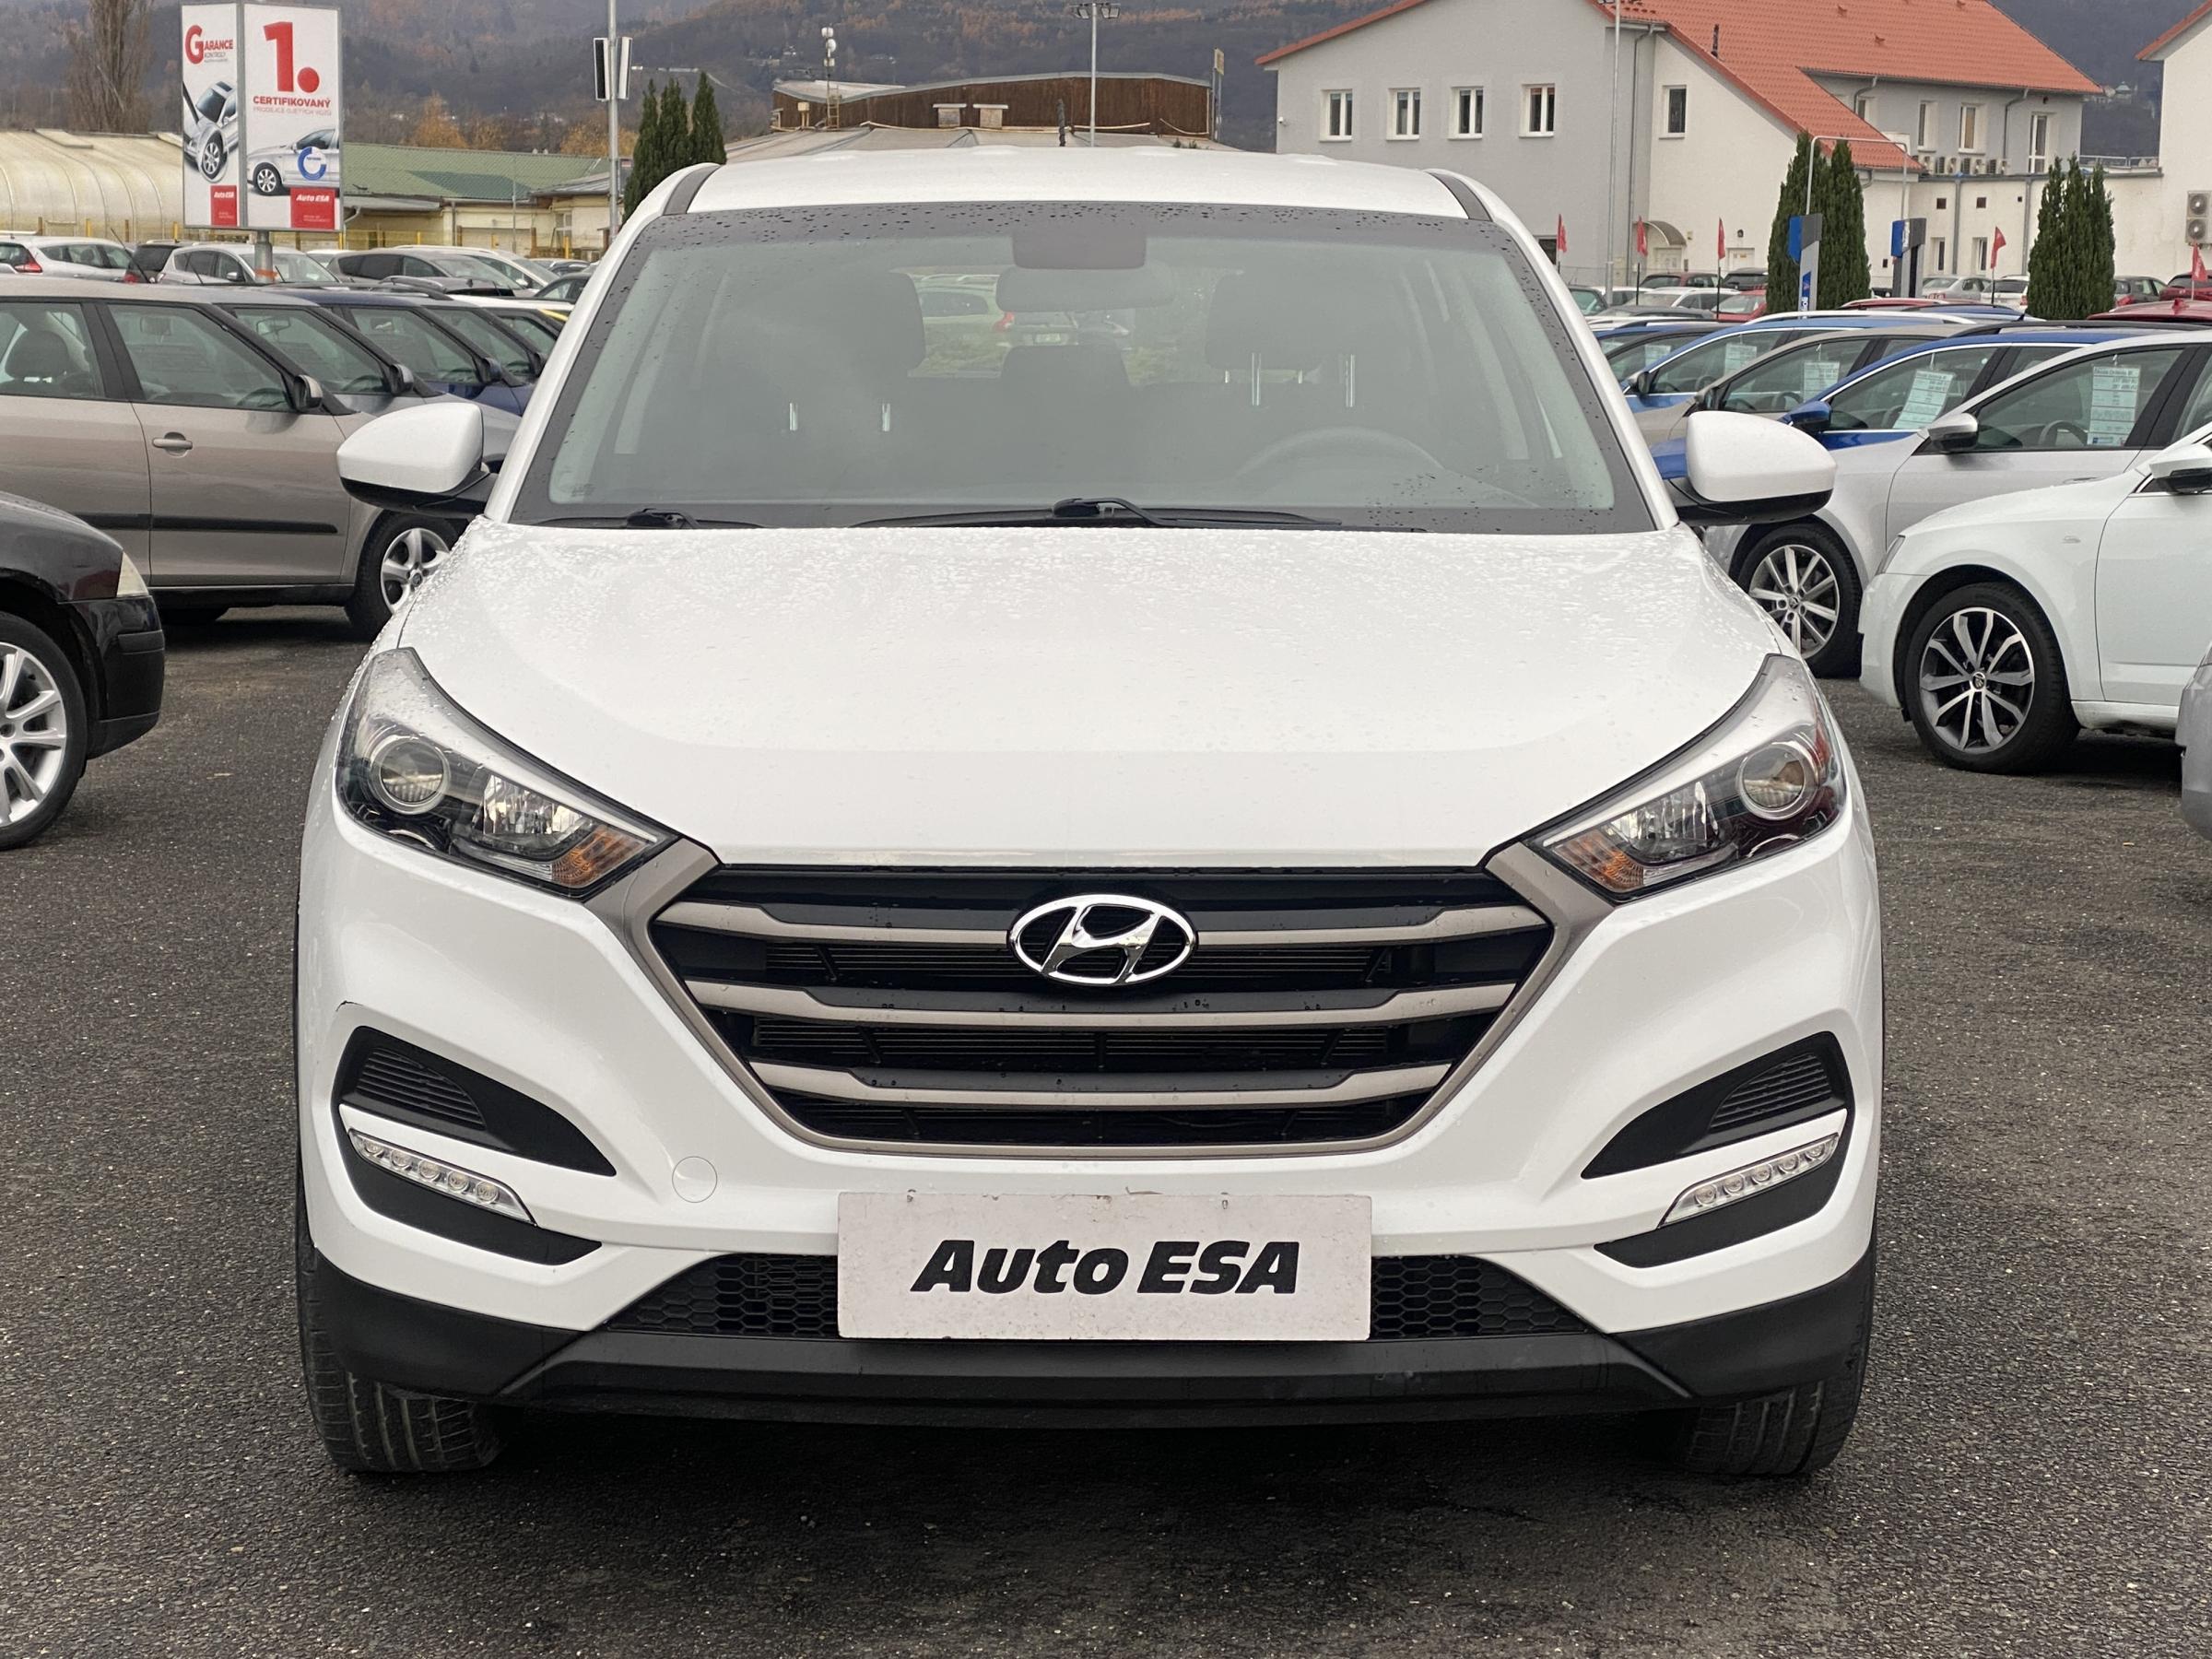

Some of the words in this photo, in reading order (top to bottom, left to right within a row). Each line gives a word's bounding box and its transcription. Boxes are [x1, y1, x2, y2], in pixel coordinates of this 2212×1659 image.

[184, 24, 233, 65] GARANCE
[263, 21, 320, 93] 1.
[911, 1240, 1129, 1294] Auto
[1136, 1241, 1300, 1294] ESA
